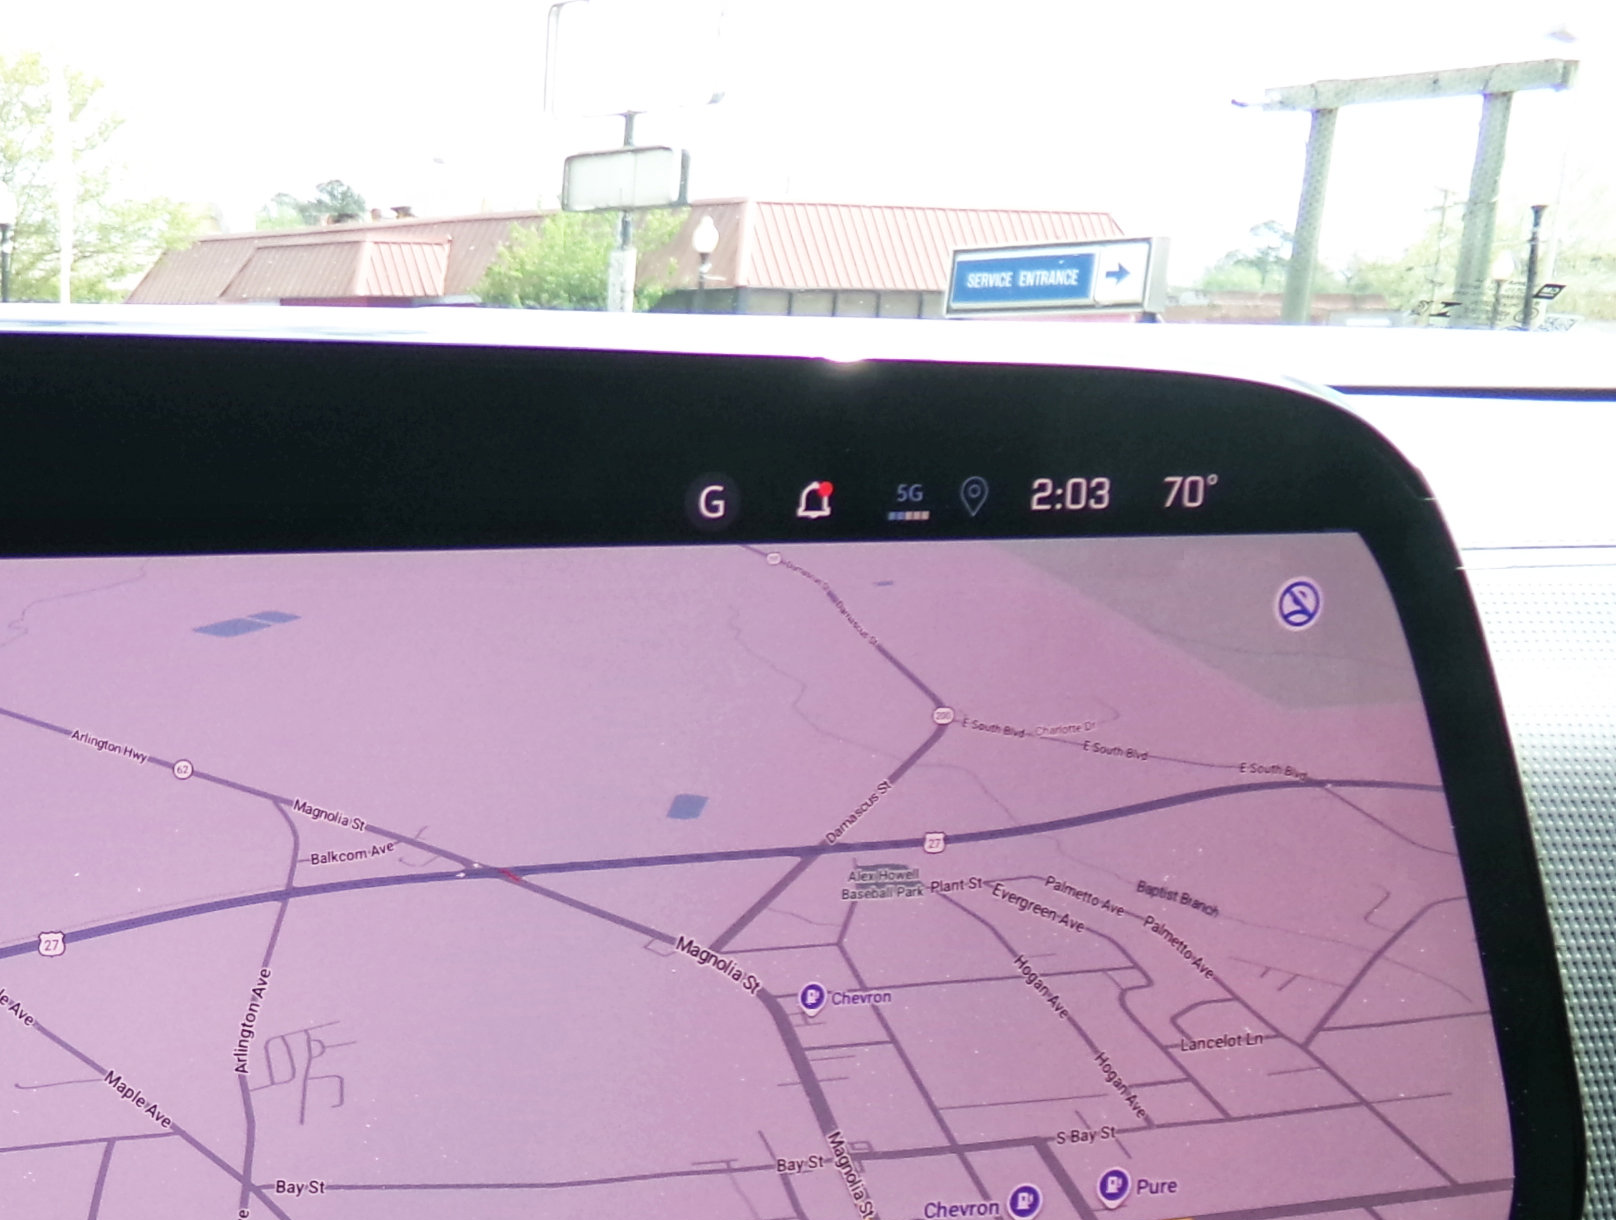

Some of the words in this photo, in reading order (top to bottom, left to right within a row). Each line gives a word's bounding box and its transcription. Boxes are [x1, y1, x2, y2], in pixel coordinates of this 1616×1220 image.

[966, 271, 1013, 288] SERVICE
[1018, 269, 1079, 287] ENTRANCE
[700, 486, 725, 518] G
[897, 484, 923, 502] 5G
[1031, 477, 1110, 511] 2:03
[971, 719, 1001, 734] South
[1003, 725, 1025, 738] Blvd
[1036, 722, 1082, 737] Charlotte
[71, 730, 121, 754] Arlington
[124, 746, 147, 764] Hwy
[1093, 742, 1124, 757] South
[1127, 748, 1148, 760] Blvd
[177, 765, 189, 774] 62
[1249, 763, 1282, 776] South
[1285, 766, 1307, 781] Blvd
[293, 799, 349, 827] Magnolia
[351, 818, 365, 832] St
[825, 792, 879, 844] Damascus
[877, 781, 892, 795] St
[311, 849, 367, 865] Balkcom
[371, 841, 394, 857] Ave
[928, 839, 940, 848] 27
[849, 871, 876, 882] Alex
[879, 869, 919, 881] Howell
[930, 880, 964, 893] Plant
[969, 877, 982, 889] St
[842, 887, 893, 900] Baseball
[897, 886, 924, 898] Park
[1045, 876, 1099, 907] Palmetto
[1100, 899, 1125, 917] Ave
[1137, 880, 1179, 903] Baptist
[1180, 893, 1219, 918] Branch
[992, 883, 1056, 920] Evergreen
[1059, 913, 1085, 933] Ave
[44, 939, 59, 951] 27
[1143, 914, 1194, 961] Palmetto
[1190, 956, 1214, 980] Ave
[675, 936, 743, 983] Magnolia
[743, 975, 761, 995] St
[1014, 955, 1051, 998] Hogan
[1047, 994, 1069, 1020] Ave
[832, 991, 892, 1006] Chevron
[8, 1002, 35, 1026] Ave
[235, 1001, 260, 1074] Arlington
[251, 968, 271, 999] Ave
[1181, 1035, 1242, 1052] Lancelot
[1246, 1033, 1263, 1045] Ln
[1095, 1051, 1130, 1098] Hogan
[1125, 1094, 1147, 1120] Ave
[104, 1070, 146, 1109] Maple
[144, 1104, 172, 1128] Ave
[1057, 1132, 1066, 1145] S
[1071, 1128, 1097, 1144] Bay
[1101, 1125, 1116, 1139] St
[777, 1158, 805, 1173] Bay
[808, 1155, 824, 1169] St
[827, 1131, 866, 1202] Magnolia
[859, 1200, 875, 1219] St
[276, 1180, 304, 1195] Bay
[309, 1180, 325, 1194] St
[1137, 1179, 1177, 1195] Pure
[924, 1201, 999, 1219] Chevron
